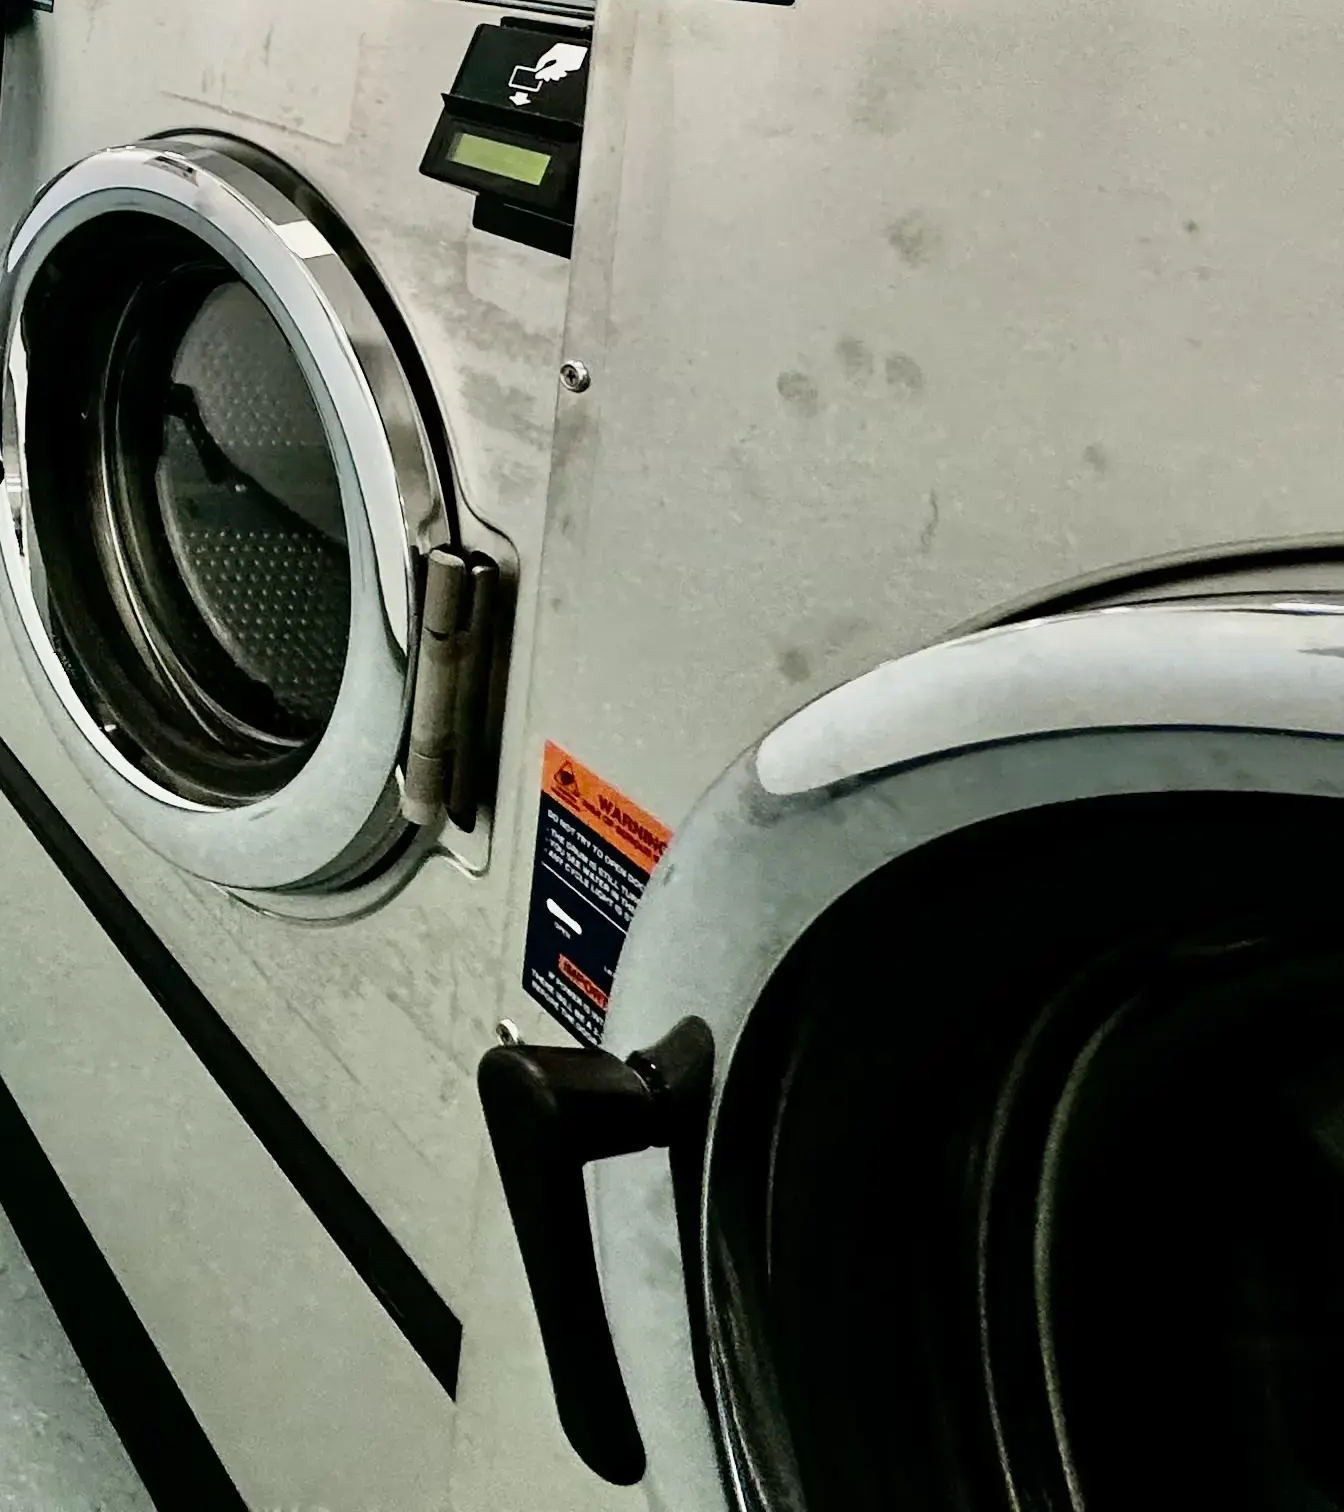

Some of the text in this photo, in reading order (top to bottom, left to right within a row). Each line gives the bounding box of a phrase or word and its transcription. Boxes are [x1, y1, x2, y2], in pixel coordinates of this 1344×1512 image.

[547, 808, 628, 878] DO NOT TRY TO OPEN
[549, 838, 566, 857] YOU
[566, 851, 581, 870] SEE
[582, 865, 610, 893] WATER
[551, 828, 565, 846] THE
[565, 840, 589, 864] DRUM
[597, 866, 621, 891] STILL
[564, 863, 590, 889] CYCLE
[590, 883, 614, 908] LIGHT
